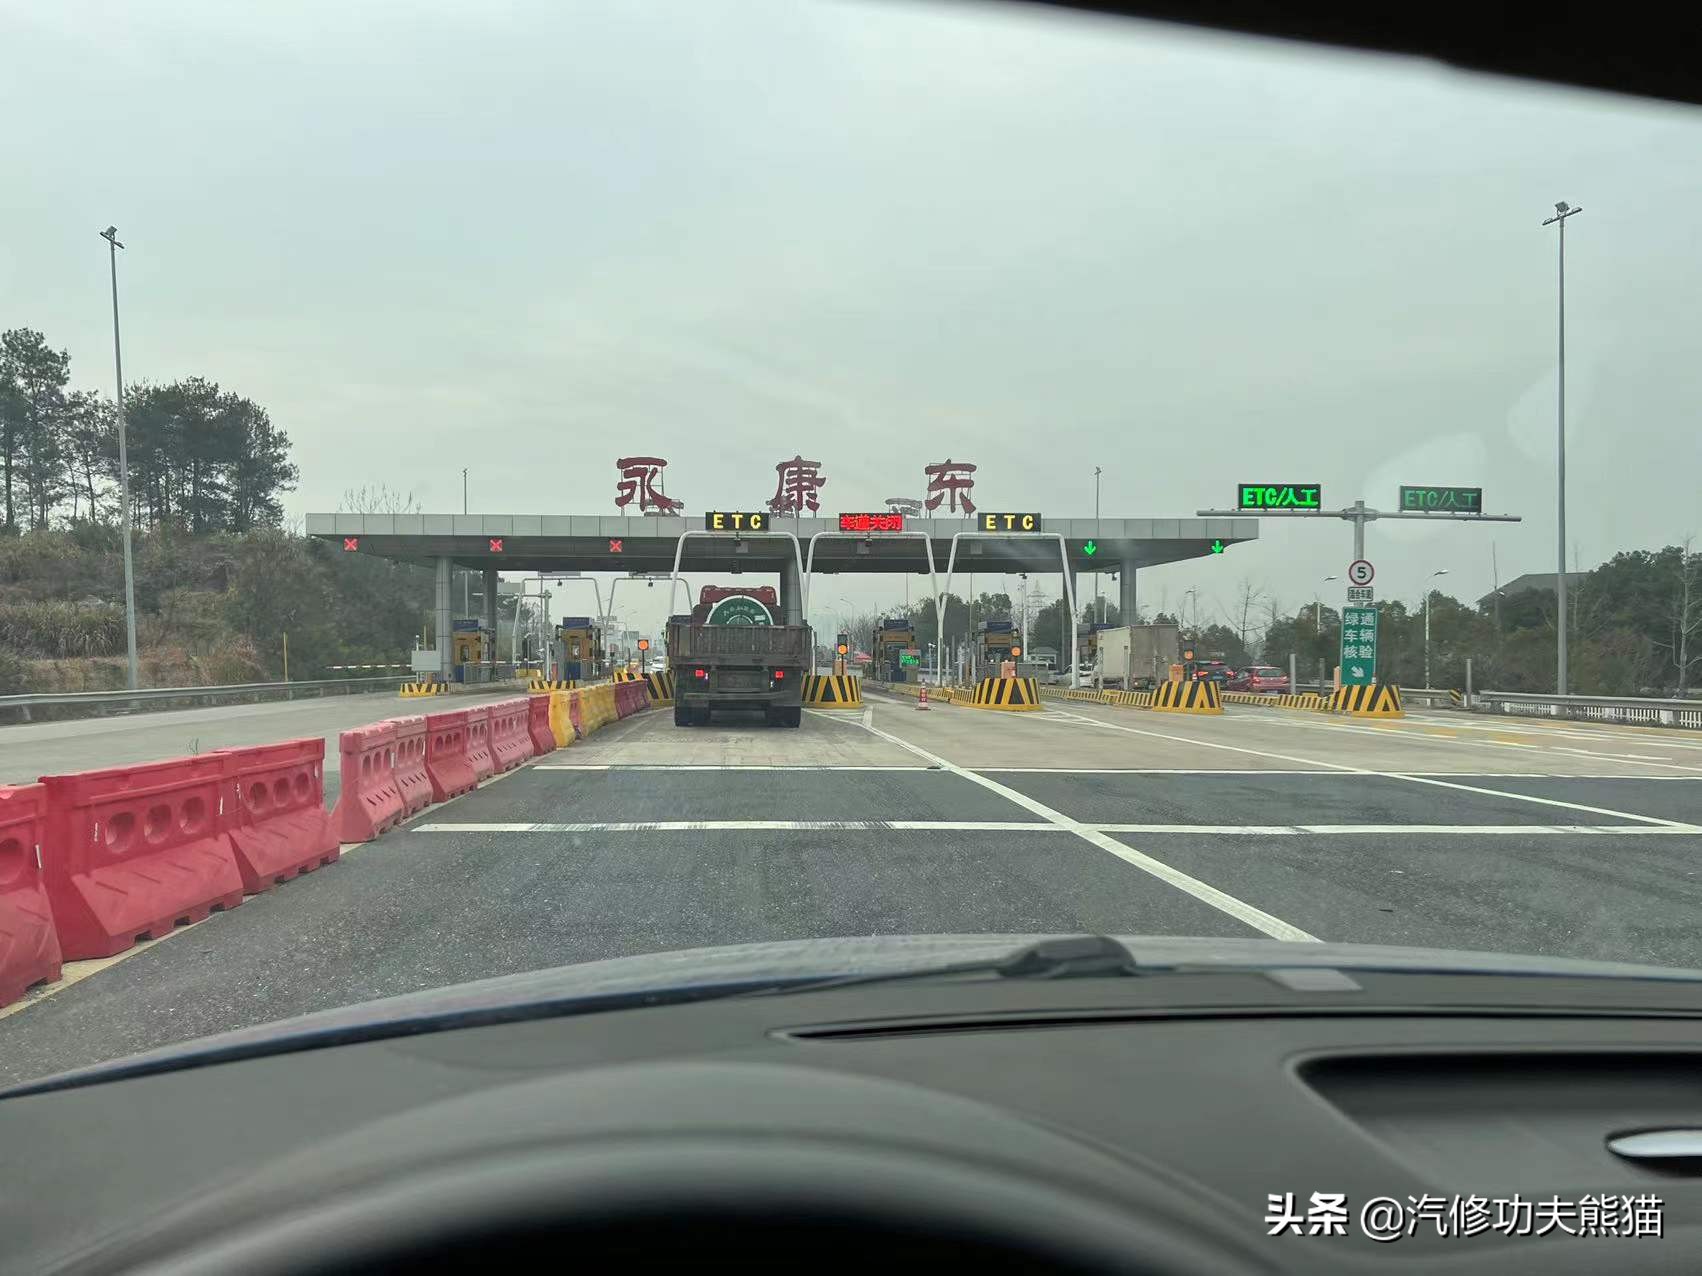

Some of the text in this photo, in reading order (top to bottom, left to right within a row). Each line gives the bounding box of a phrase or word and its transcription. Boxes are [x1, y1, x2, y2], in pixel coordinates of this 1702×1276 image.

[616, 455, 977, 513] 永康东
[1242, 487, 1319, 507] ETC/人工
[1403, 489, 1477, 507] ETC/人工
[713, 514, 761, 528] ETC
[986, 515, 1034, 529] ETC
[1357, 567, 1366, 578] 5
[1345, 612, 1374, 626] 绿通
[1344, 629, 1374, 642] 车辆
[1343, 645, 1373, 659] 核验
